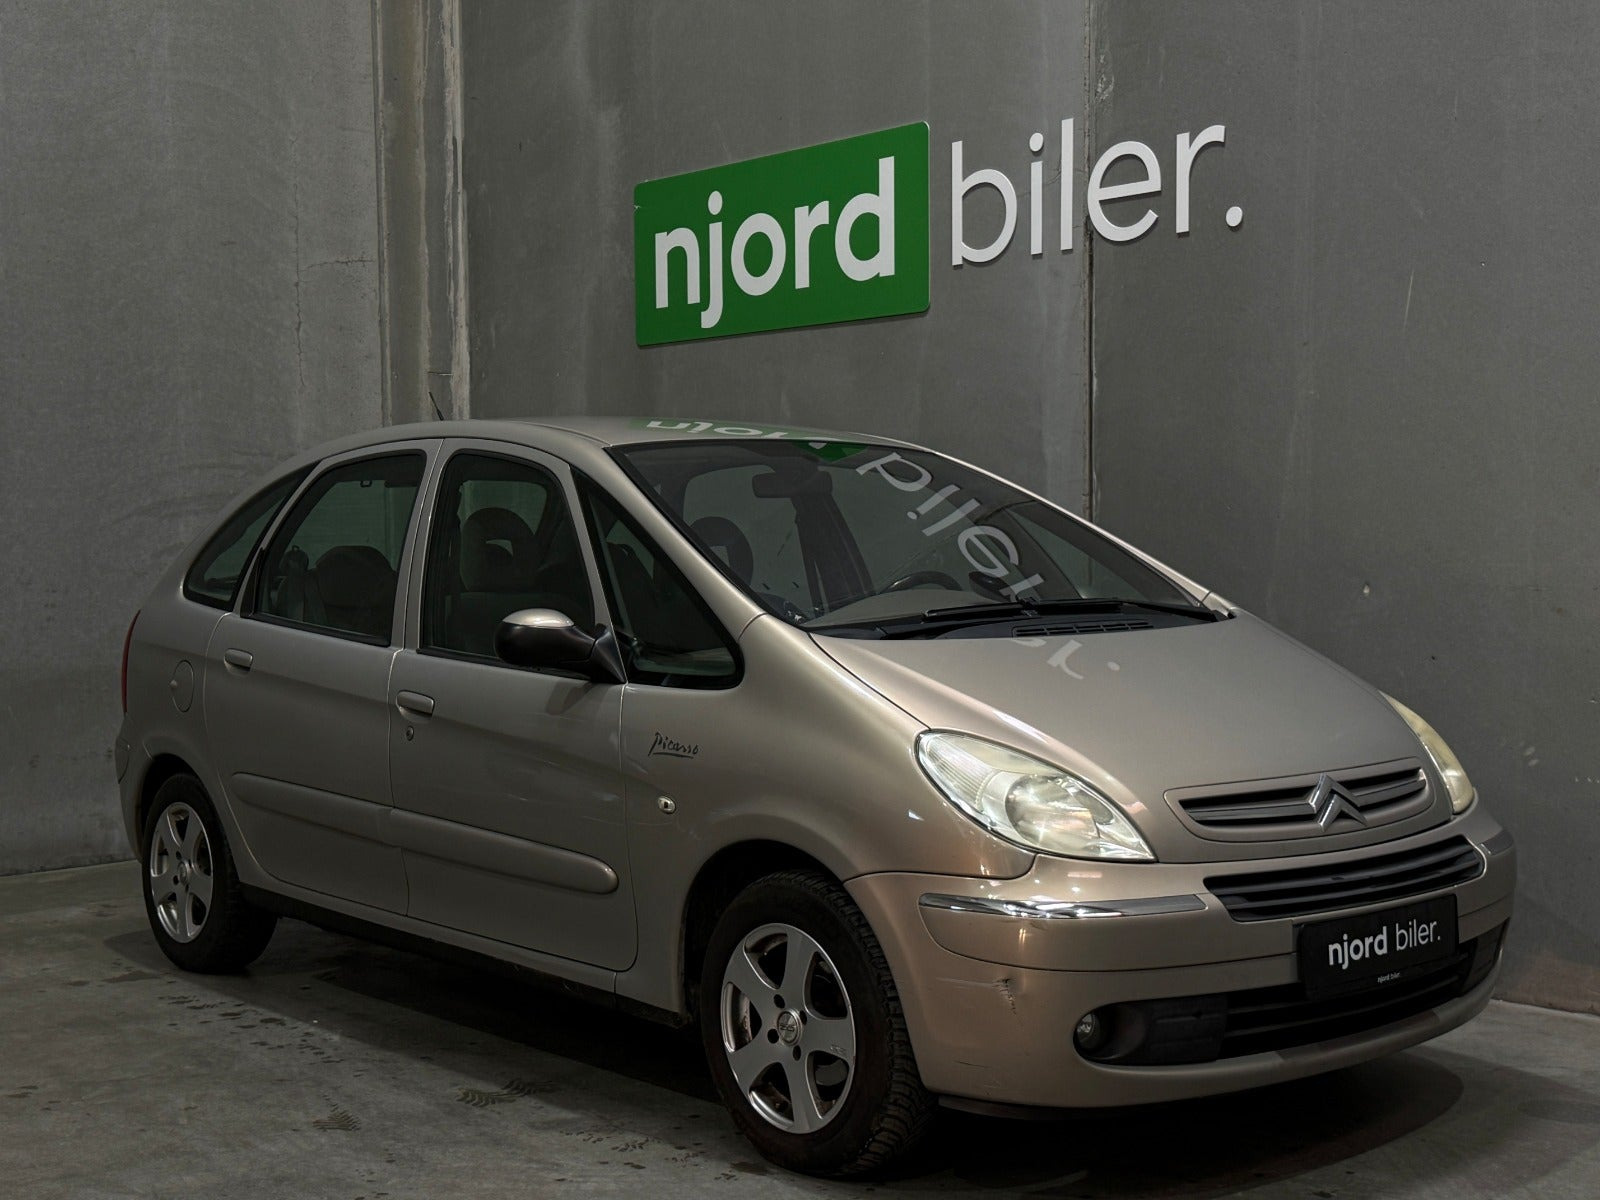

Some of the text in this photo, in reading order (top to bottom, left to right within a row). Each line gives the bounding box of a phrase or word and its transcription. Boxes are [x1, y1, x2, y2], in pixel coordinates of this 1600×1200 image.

[655, 117, 1243, 330] njord biler.
[647, 731, 699, 759] Picasso
[1328, 918, 1441, 970] njord biler.
